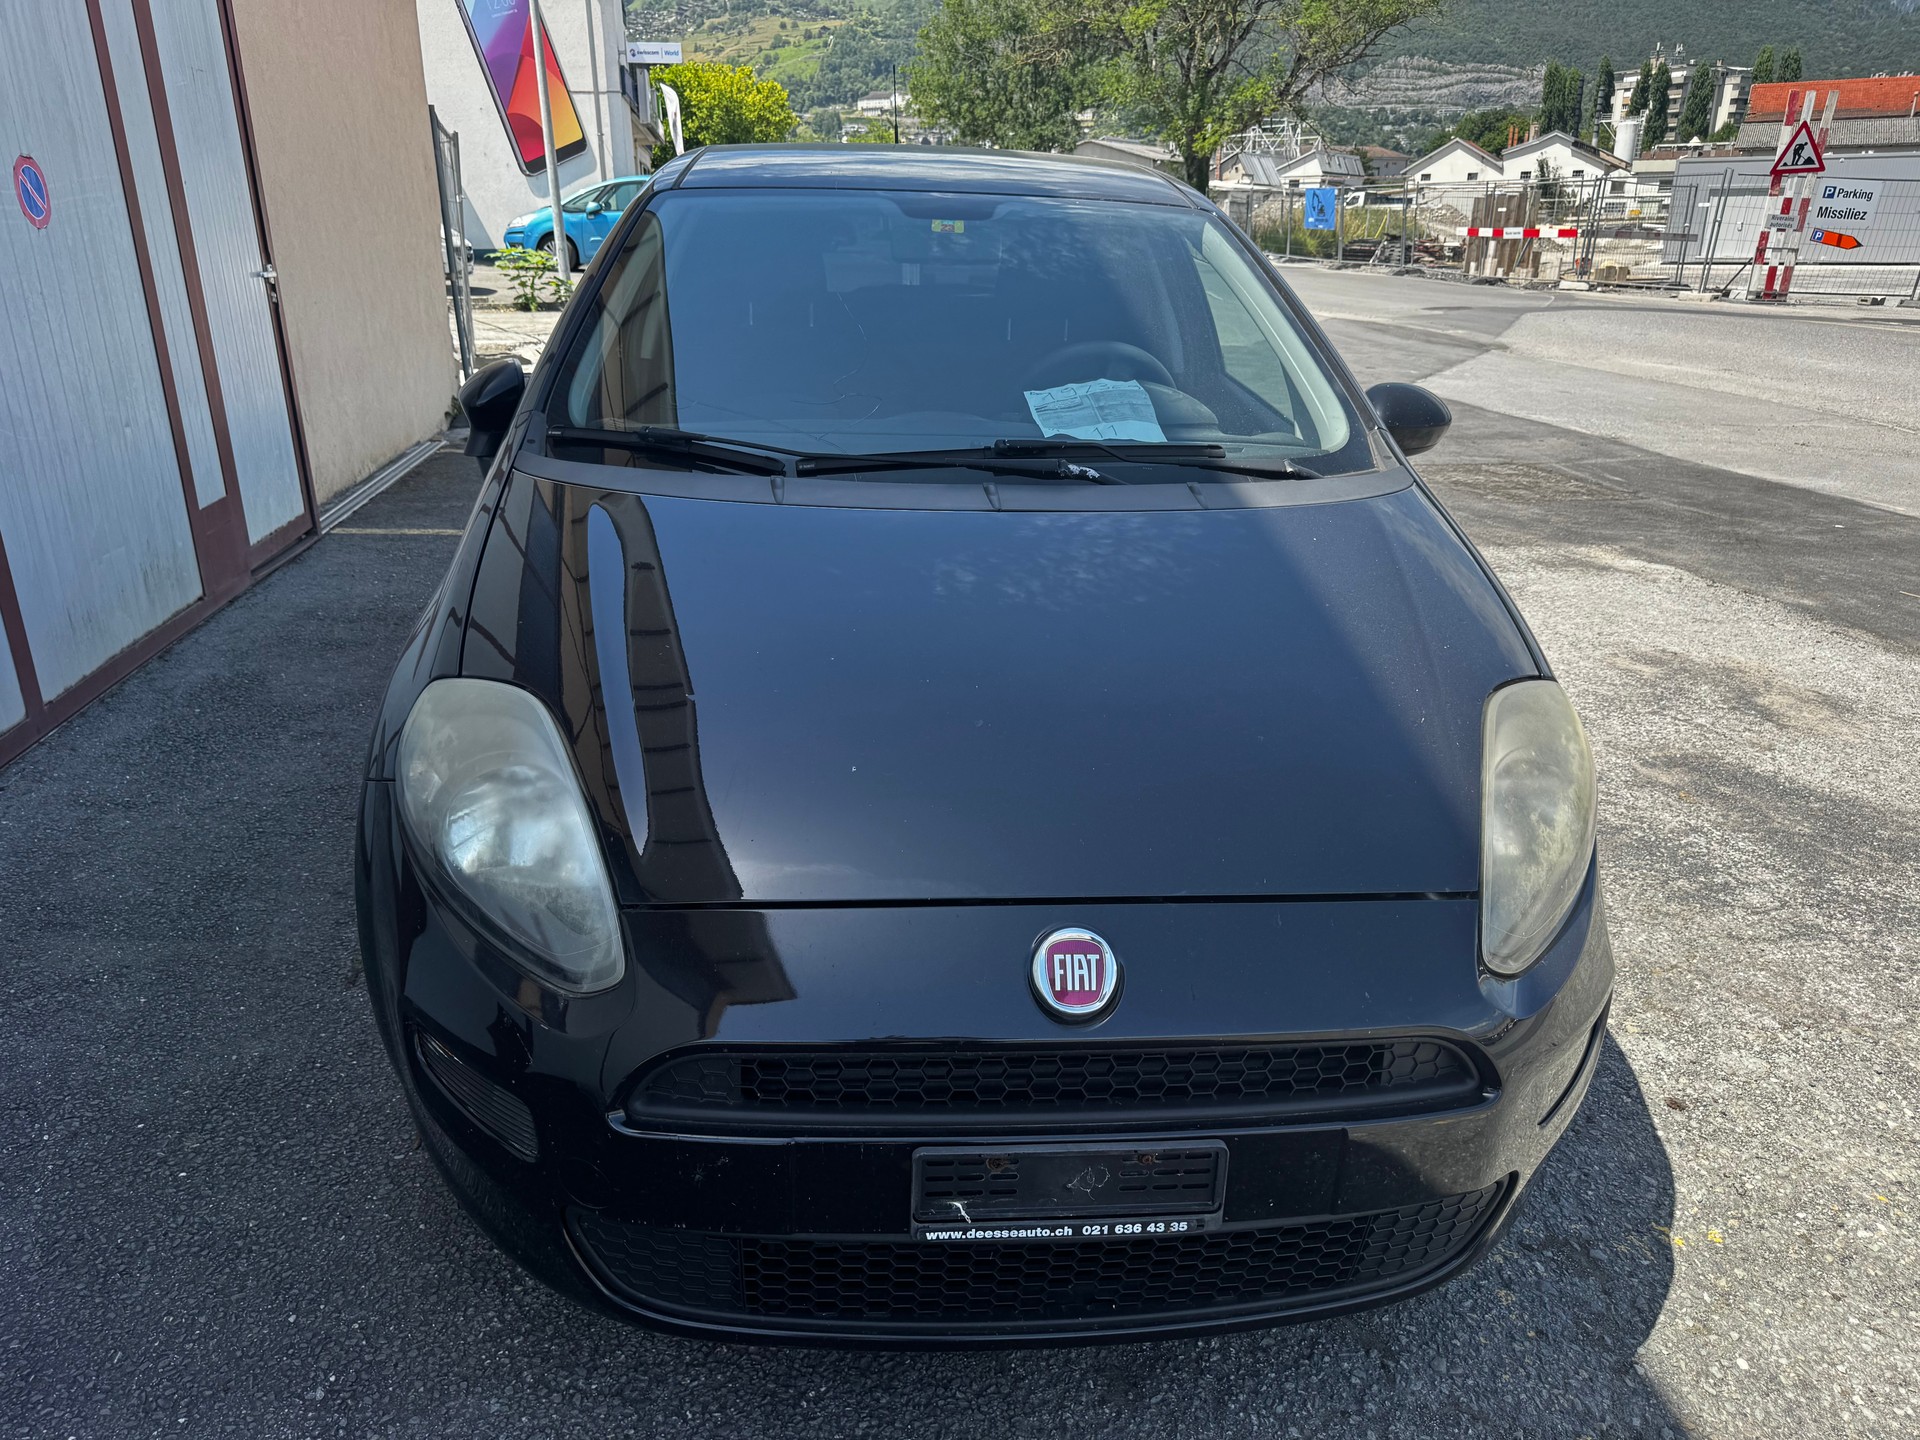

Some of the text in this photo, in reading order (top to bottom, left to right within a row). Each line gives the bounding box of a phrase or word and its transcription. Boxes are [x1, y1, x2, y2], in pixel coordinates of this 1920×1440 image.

[1837, 188, 1873, 202] Parking
[1771, 214, 1795, 222] Riverains
[1816, 206, 1868, 220] Missiliez
[1769, 221, 1793, 229] autorisés
[1053, 954, 1100, 991] FIAT
[926, 1222, 1188, 1240] www.deesseauto.ch 021 636 43 35
